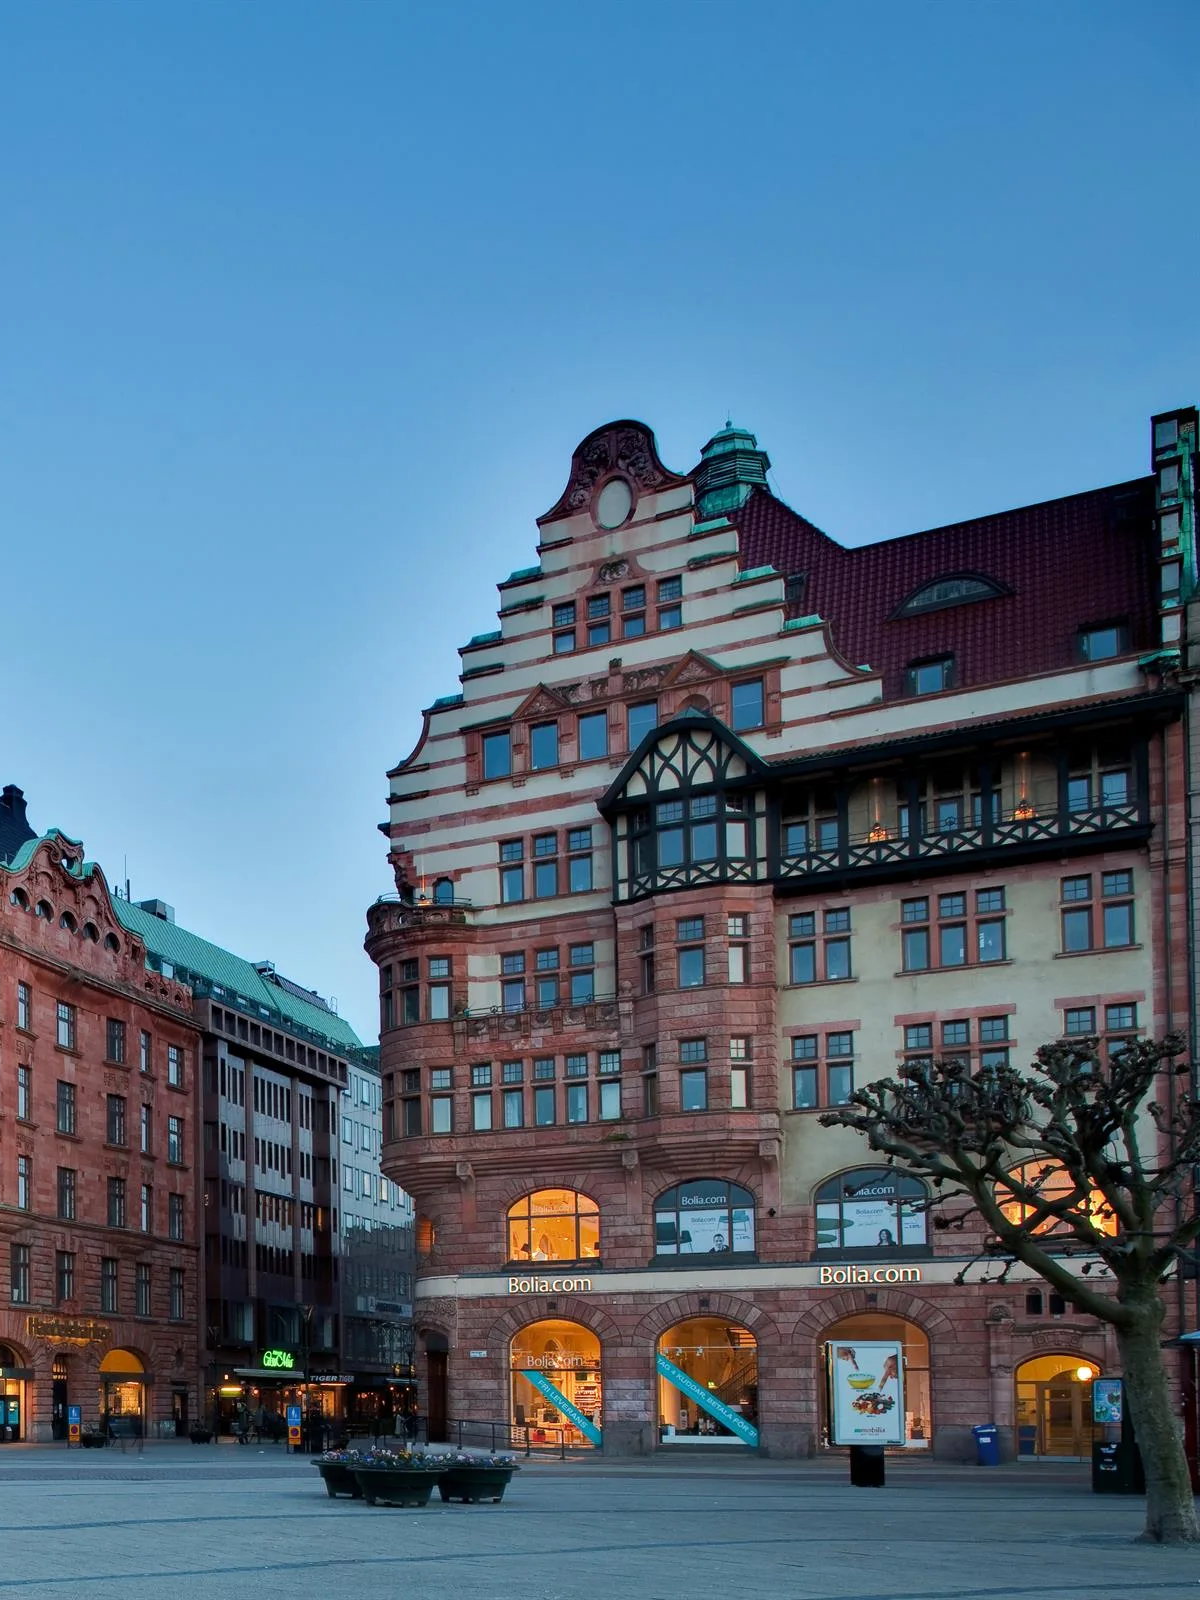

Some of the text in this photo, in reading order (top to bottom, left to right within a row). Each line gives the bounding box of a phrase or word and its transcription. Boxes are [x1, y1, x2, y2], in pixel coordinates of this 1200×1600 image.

[681, 1195, 726, 1206] Bolia.com
[819, 1265, 921, 1284] Bolia.com
[507, 1276, 592, 1293] Bolia.com
[657, 1358, 671, 1373] TAG
[706, 1397, 733, 1419] BETALA
[537, 1379, 588, 1430] FRI LEVERANS
